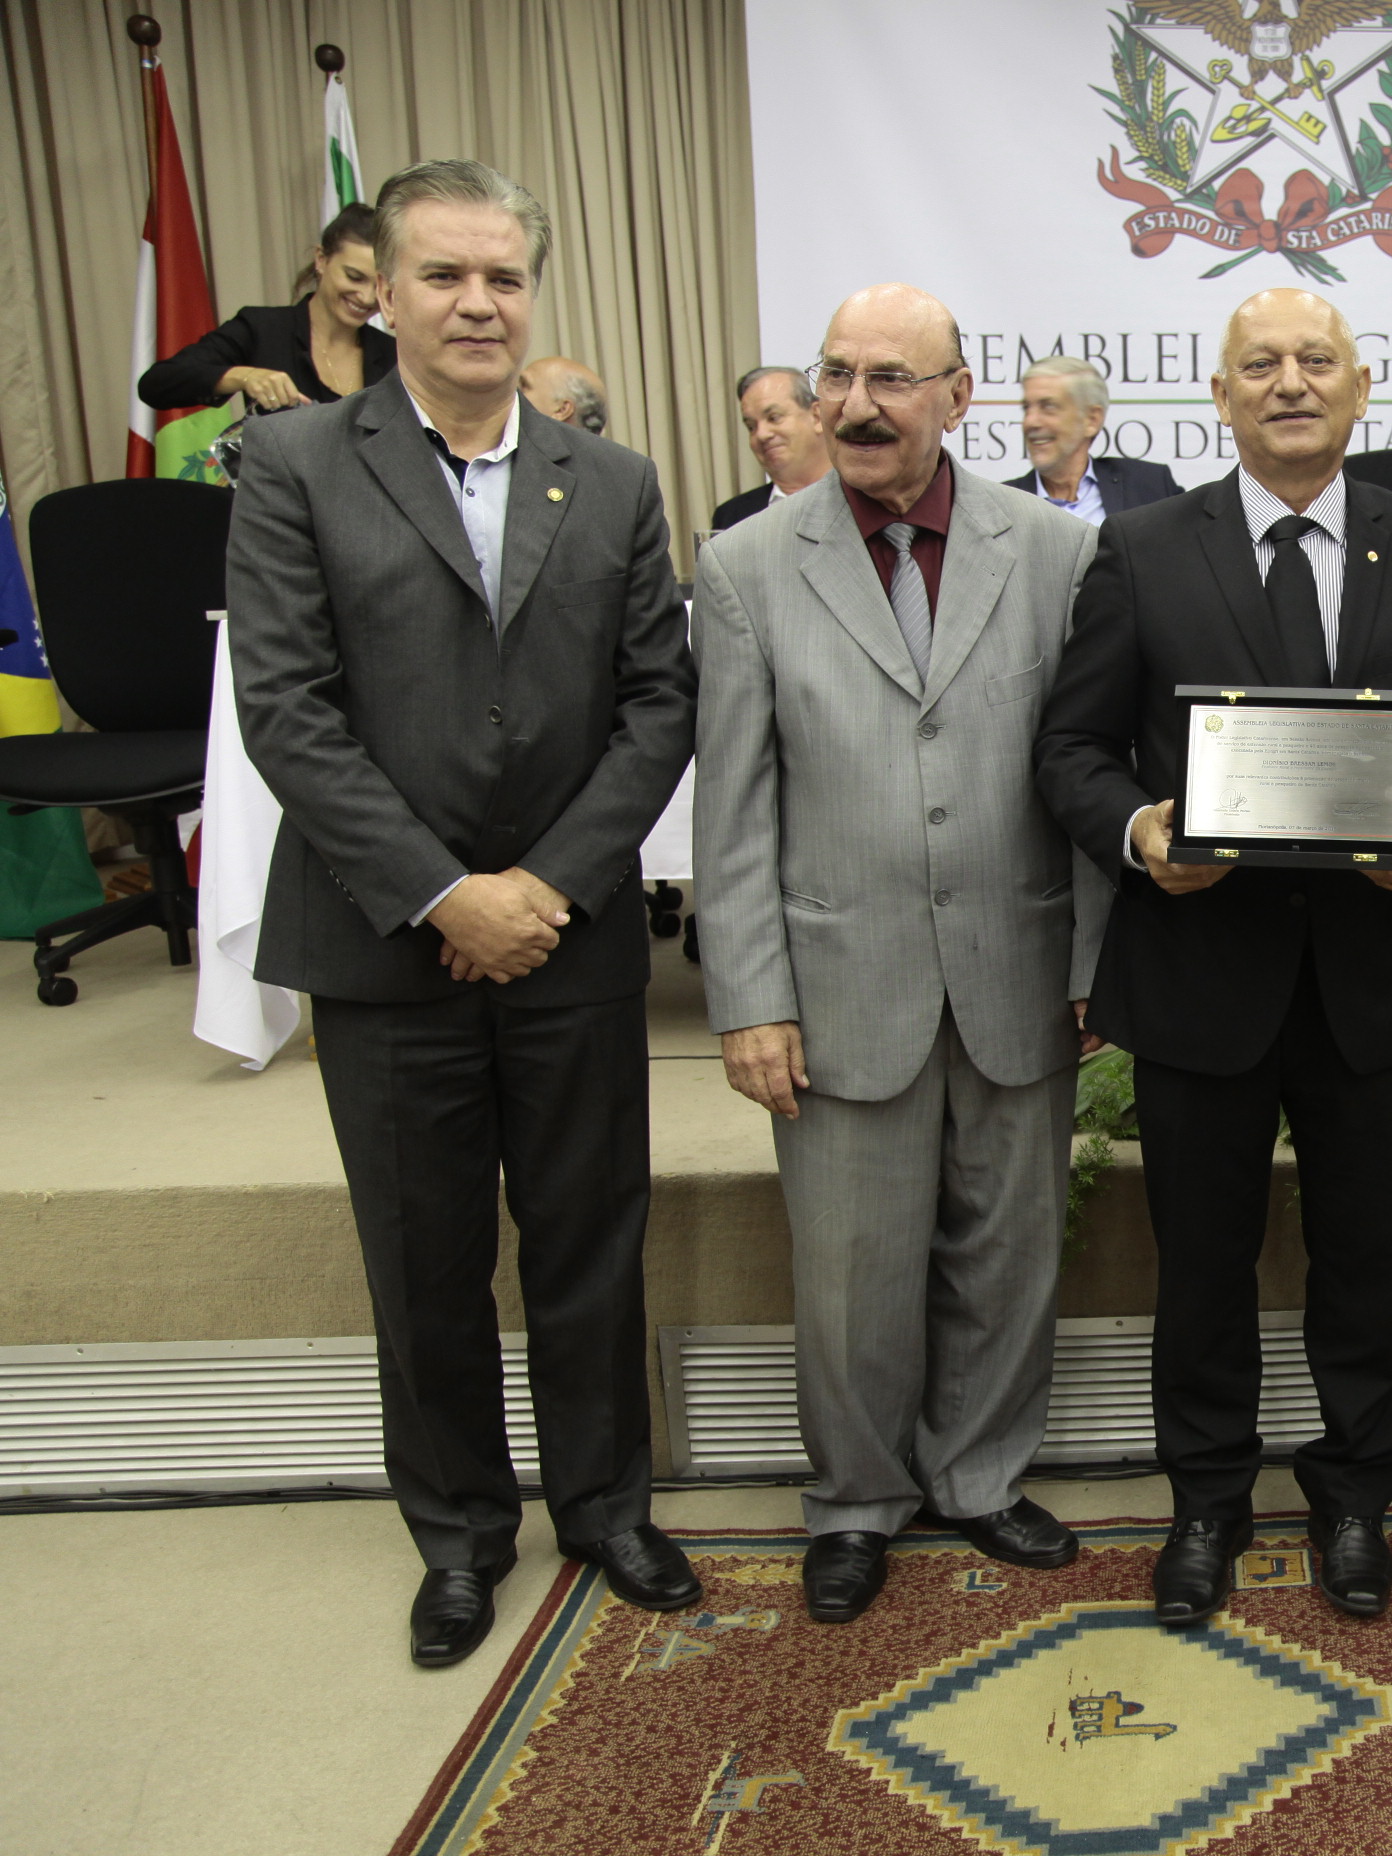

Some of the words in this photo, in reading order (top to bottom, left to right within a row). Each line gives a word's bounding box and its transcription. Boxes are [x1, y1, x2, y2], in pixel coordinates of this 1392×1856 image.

[1131, 210, 1211, 238] ESTADO
[1213, 223, 1242, 248] DE
[960, 332, 1211, 385] EMBLEI
[1174, 420, 1236, 460] DE
[1269, 720, 1305, 728] LEGISLATIVA
